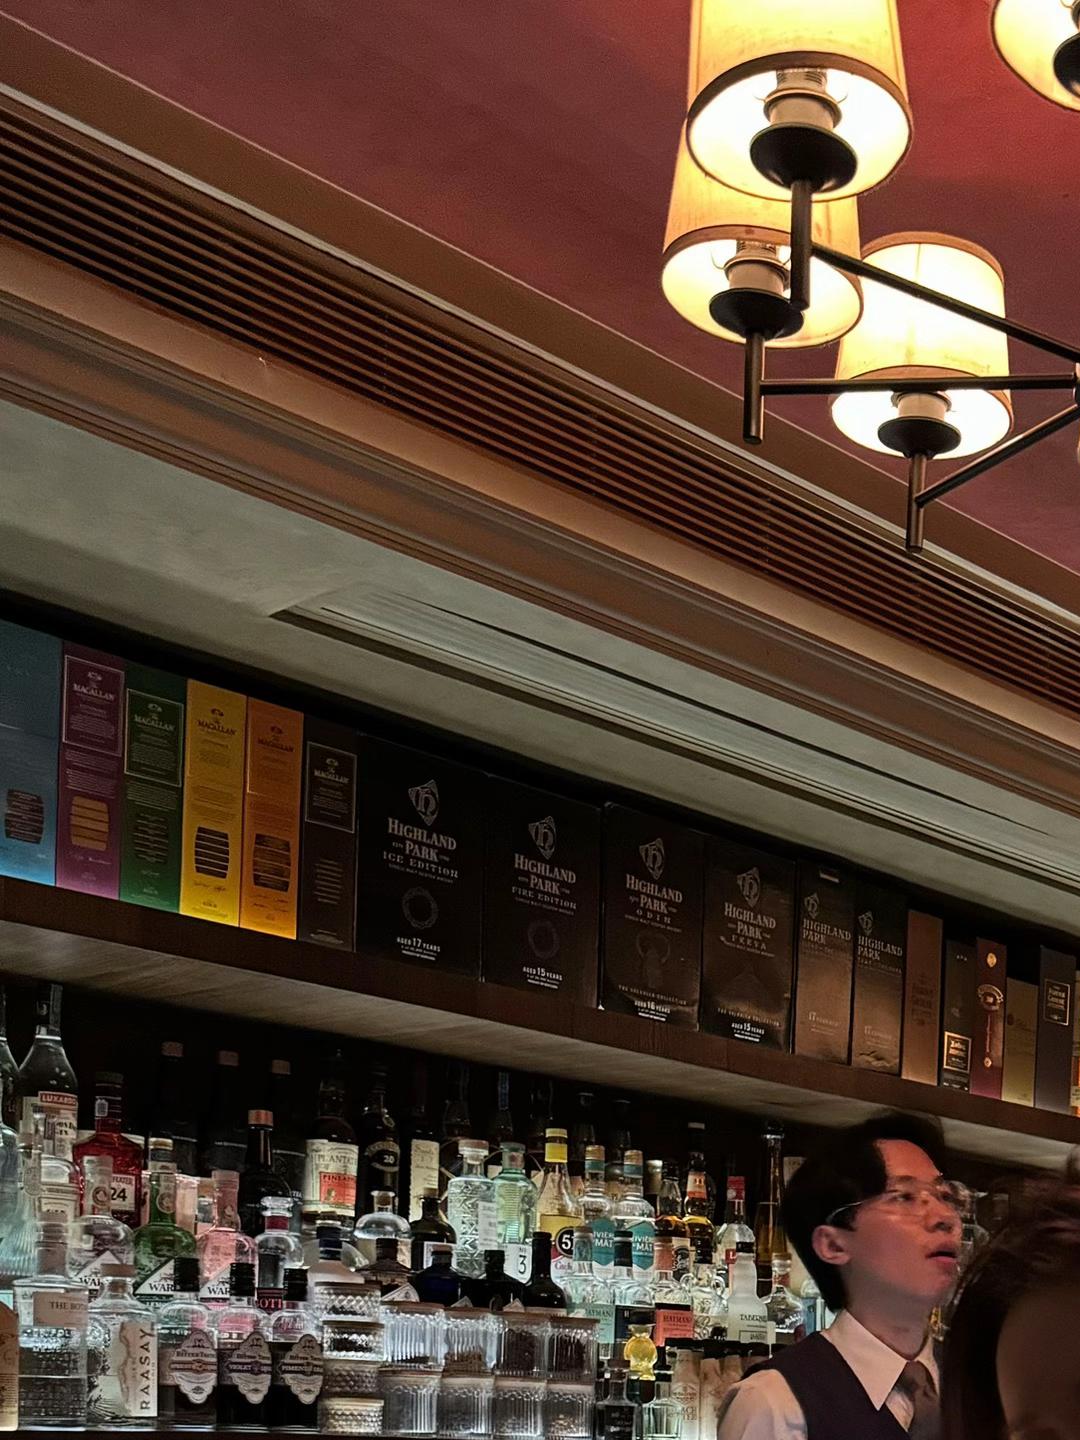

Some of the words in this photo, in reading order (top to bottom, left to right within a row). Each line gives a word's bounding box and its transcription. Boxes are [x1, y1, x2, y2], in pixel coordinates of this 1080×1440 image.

[387, 816, 457, 851] HIGHLAND
[405, 840, 440, 863] PARK
[383, 850, 404, 864] ICE
[409, 857, 460, 879] EDITION
[514, 852, 577, 884] HIGHLAND
[530, 873, 561, 897] PARK
[625, 872, 683, 904] HIGHLAND
[640, 893, 669, 915] PARK
[724, 901, 777, 929] HIGHLAND
[737, 920, 763, 940] PARK
[802, 918, 852, 941] HIGHLAND
[802, 929, 827, 945] PARK
[857, 945, 881, 961] PARK
[858, 935, 903, 957] HIGHLAND
[110, 1187, 127, 1202] 24
[518, 1253, 528, 1276] 3
[149, 1283, 174, 1293] WAR
[207, 1286, 230, 1296] WAR
[50, 1300, 67, 1310] THE
[139, 1328, 156, 1411] RAASAY
